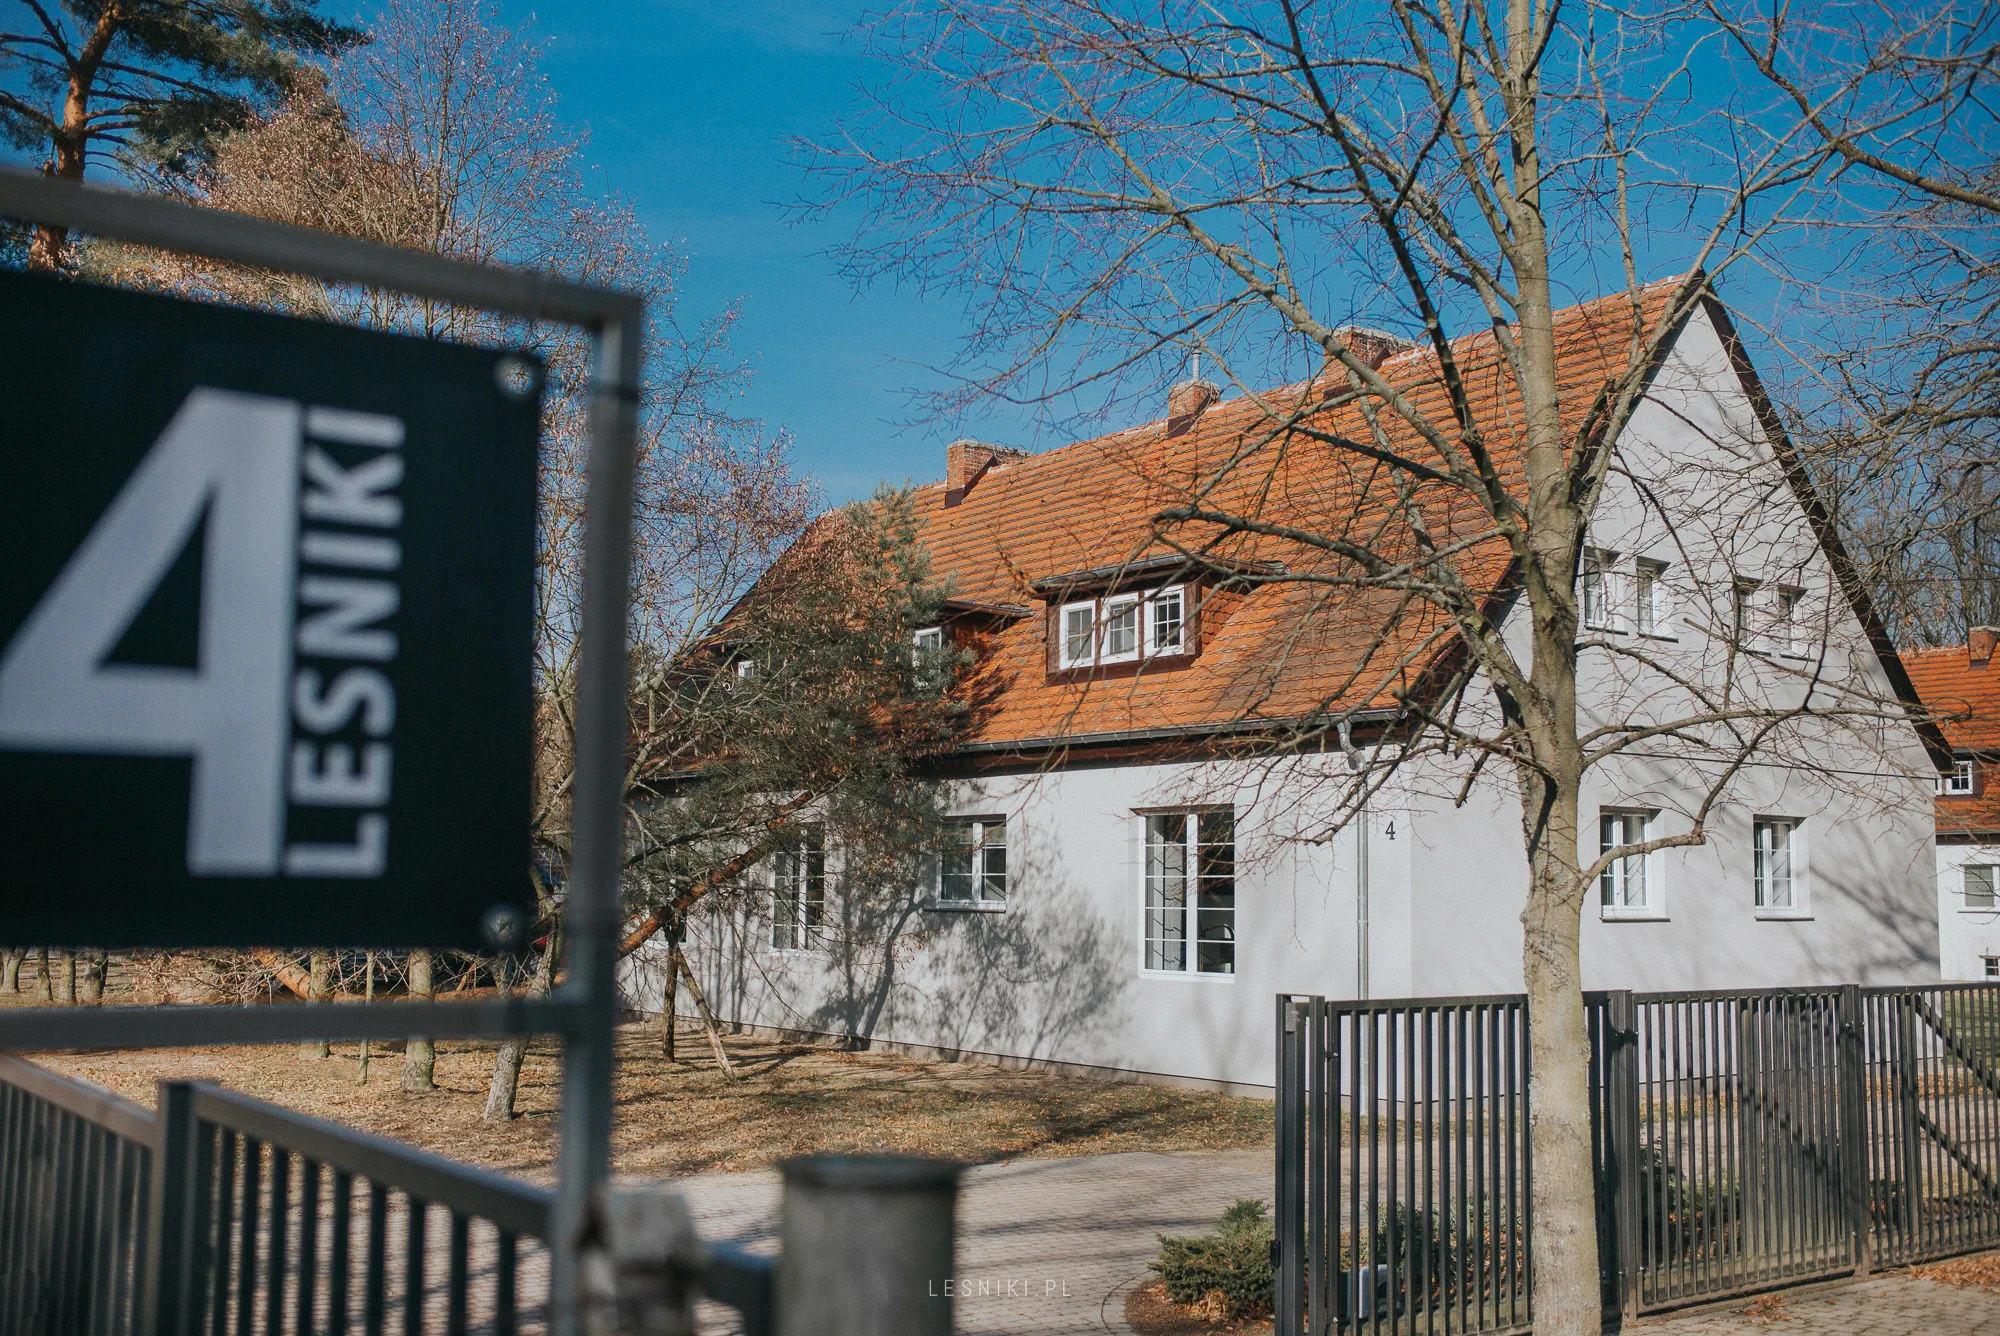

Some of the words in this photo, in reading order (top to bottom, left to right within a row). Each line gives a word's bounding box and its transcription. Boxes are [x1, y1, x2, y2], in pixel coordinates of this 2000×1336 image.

[0, 384, 299, 877] 4
[284, 405, 405, 878] LESNIKI
[1385, 820, 1396, 840] 4
